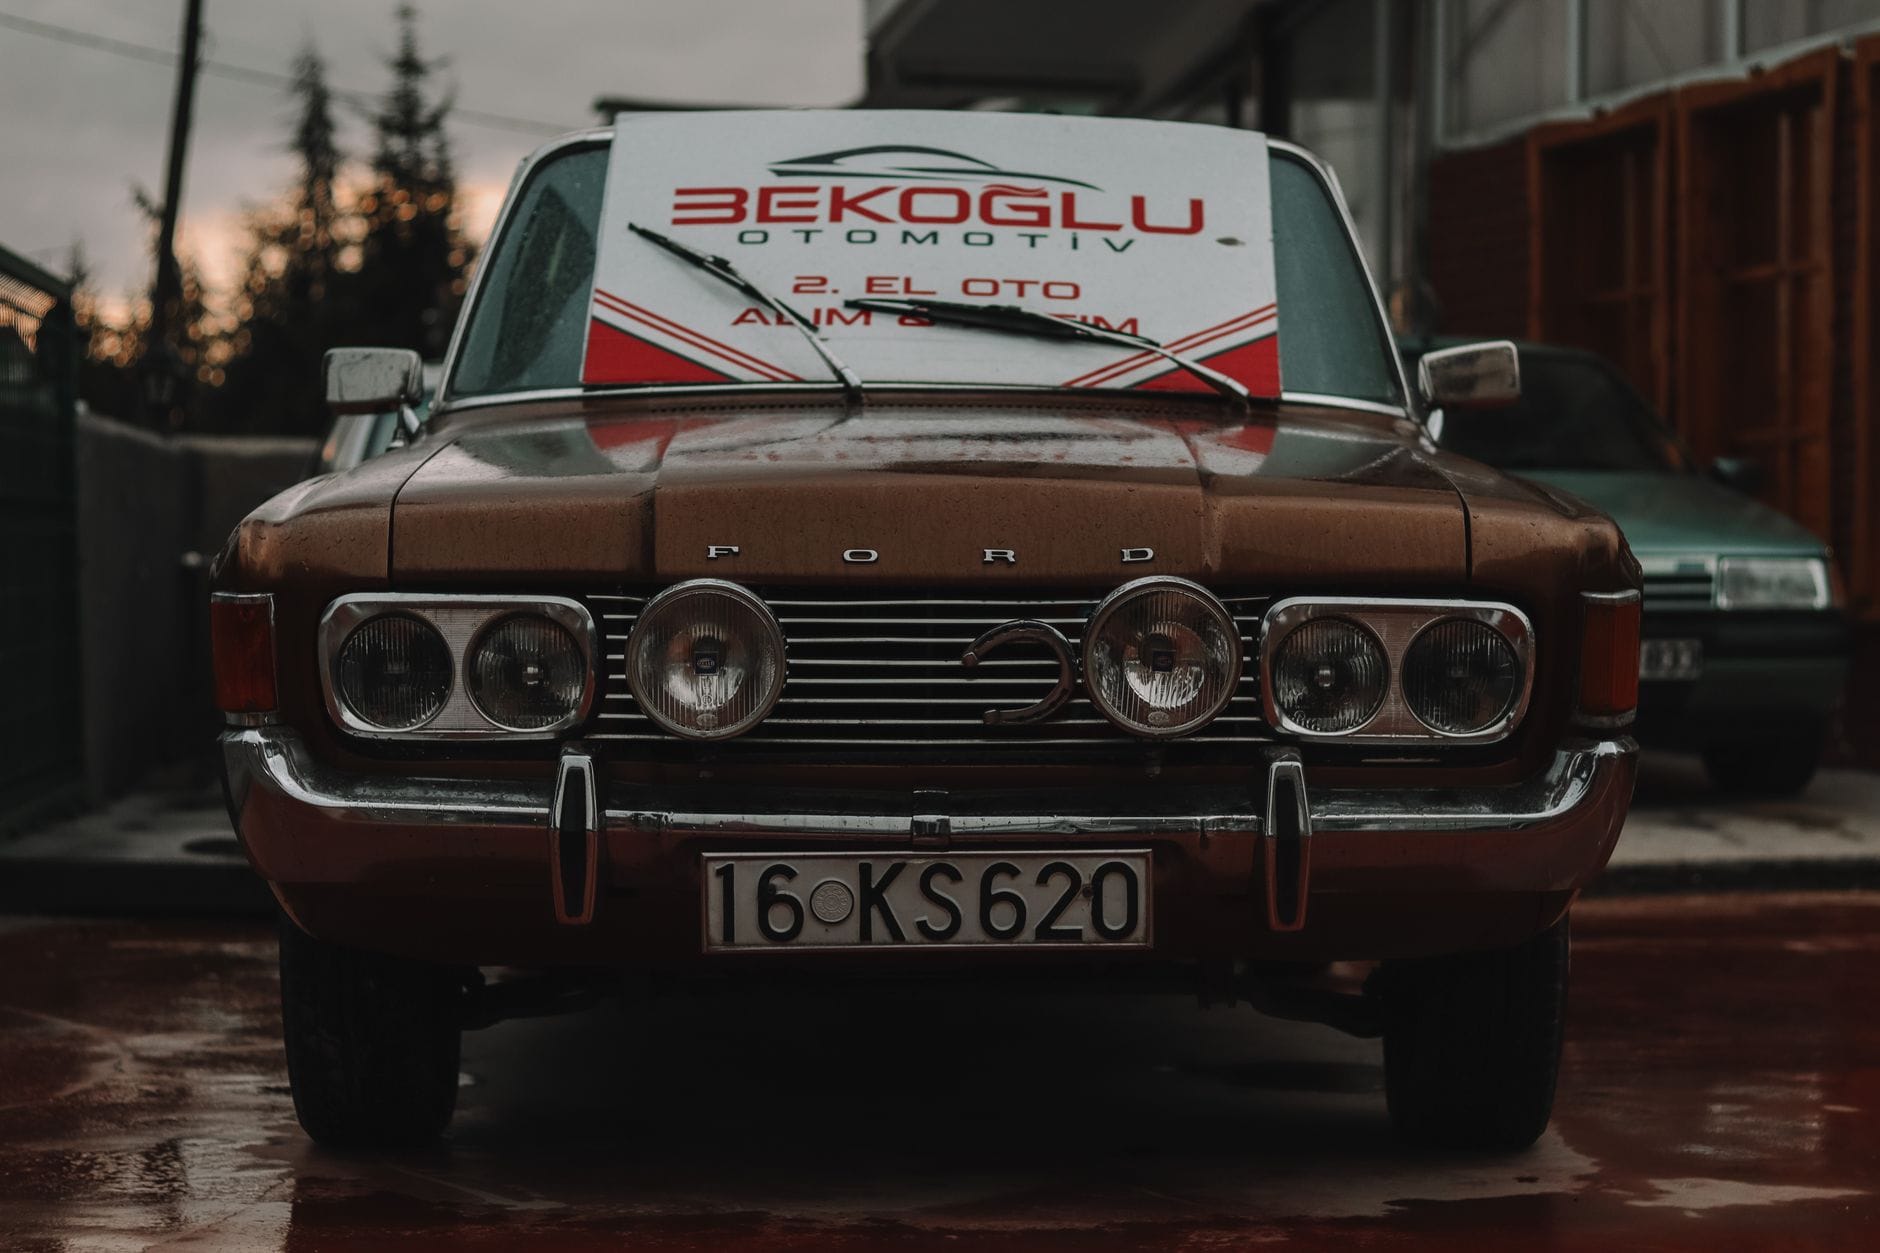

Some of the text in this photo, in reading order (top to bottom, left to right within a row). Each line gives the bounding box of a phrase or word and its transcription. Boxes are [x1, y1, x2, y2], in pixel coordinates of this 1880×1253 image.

[672, 184, 1204, 235] BEKOĞLU
[738, 229, 1134, 252] OTOMOTİV
[793, 276, 1081, 300] 2. EL OTO
[707, 545, 1154, 562] FORD
[715, 862, 804, 942] 16
